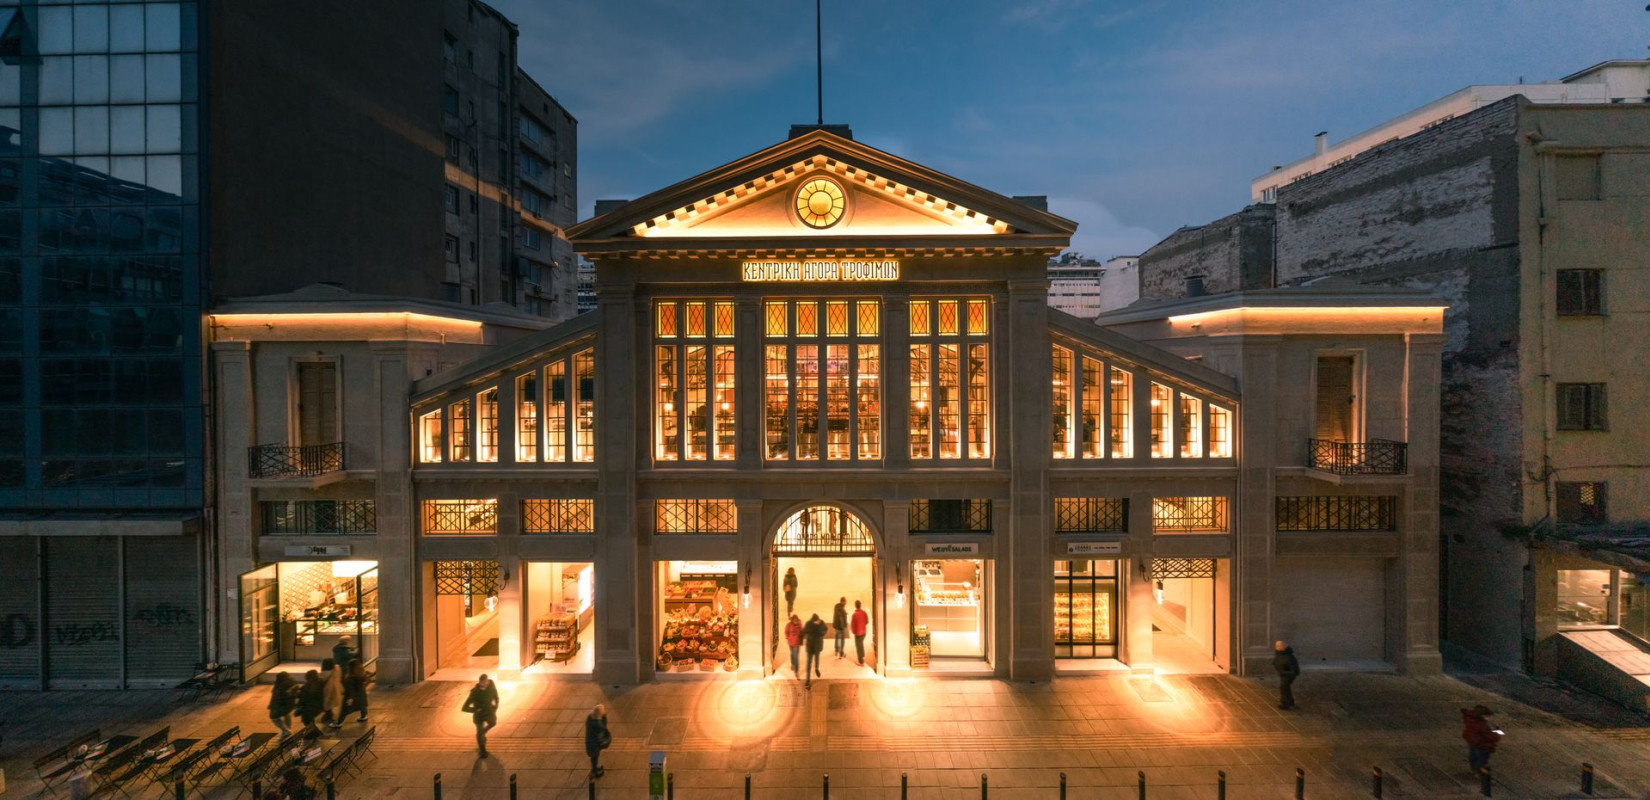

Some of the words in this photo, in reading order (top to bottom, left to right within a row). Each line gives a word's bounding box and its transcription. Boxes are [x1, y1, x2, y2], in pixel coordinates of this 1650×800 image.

[743, 261, 800, 280] ΚΕΝΤΡΙΚΗ
[803, 261, 838, 280] ΑΓΟΡΑ
[841, 261, 899, 280] ΤΡΟΦΙΜΩΝ
